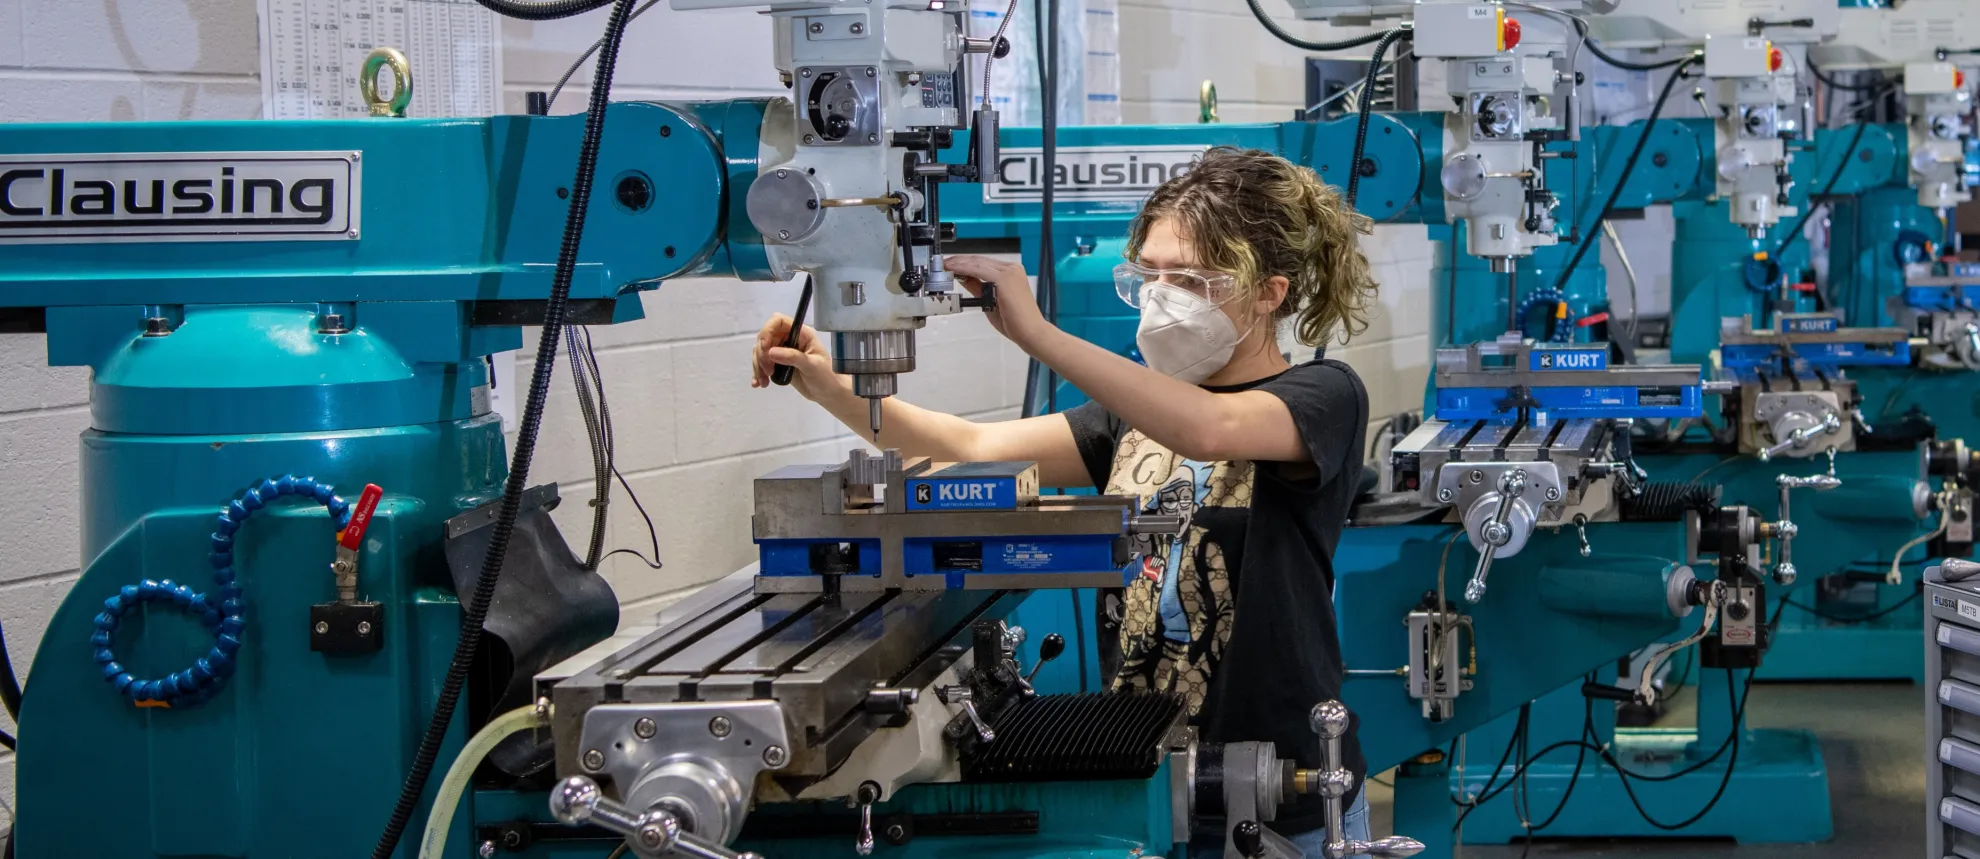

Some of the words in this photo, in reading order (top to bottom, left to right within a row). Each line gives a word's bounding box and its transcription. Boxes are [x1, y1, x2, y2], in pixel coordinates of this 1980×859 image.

[0, 167, 335, 225] Clausing
[1800, 320, 1831, 330] KURT
[1556, 354, 1600, 367] KURT
[939, 483, 997, 500] KURT
[1939, 596, 1955, 609] LISTA
